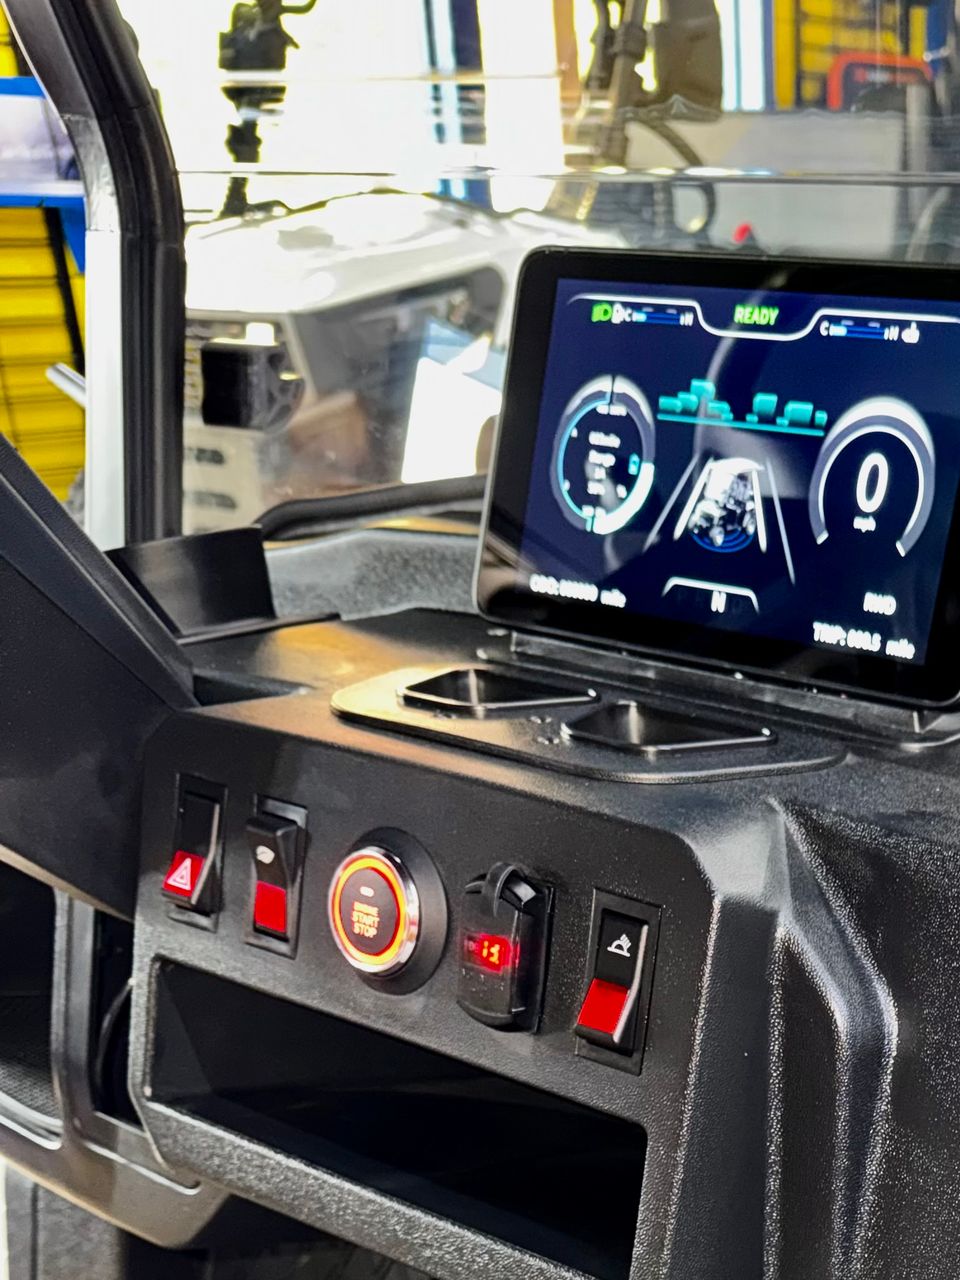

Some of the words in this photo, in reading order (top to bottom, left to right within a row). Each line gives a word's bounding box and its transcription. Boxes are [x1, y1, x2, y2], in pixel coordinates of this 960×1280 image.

[734, 305, 779, 326] READY
[856, 452, 889, 513] 0
[711, 590, 726, 613] N
[351, 911, 380, 928] START
[353, 922, 377, 938] STOP
